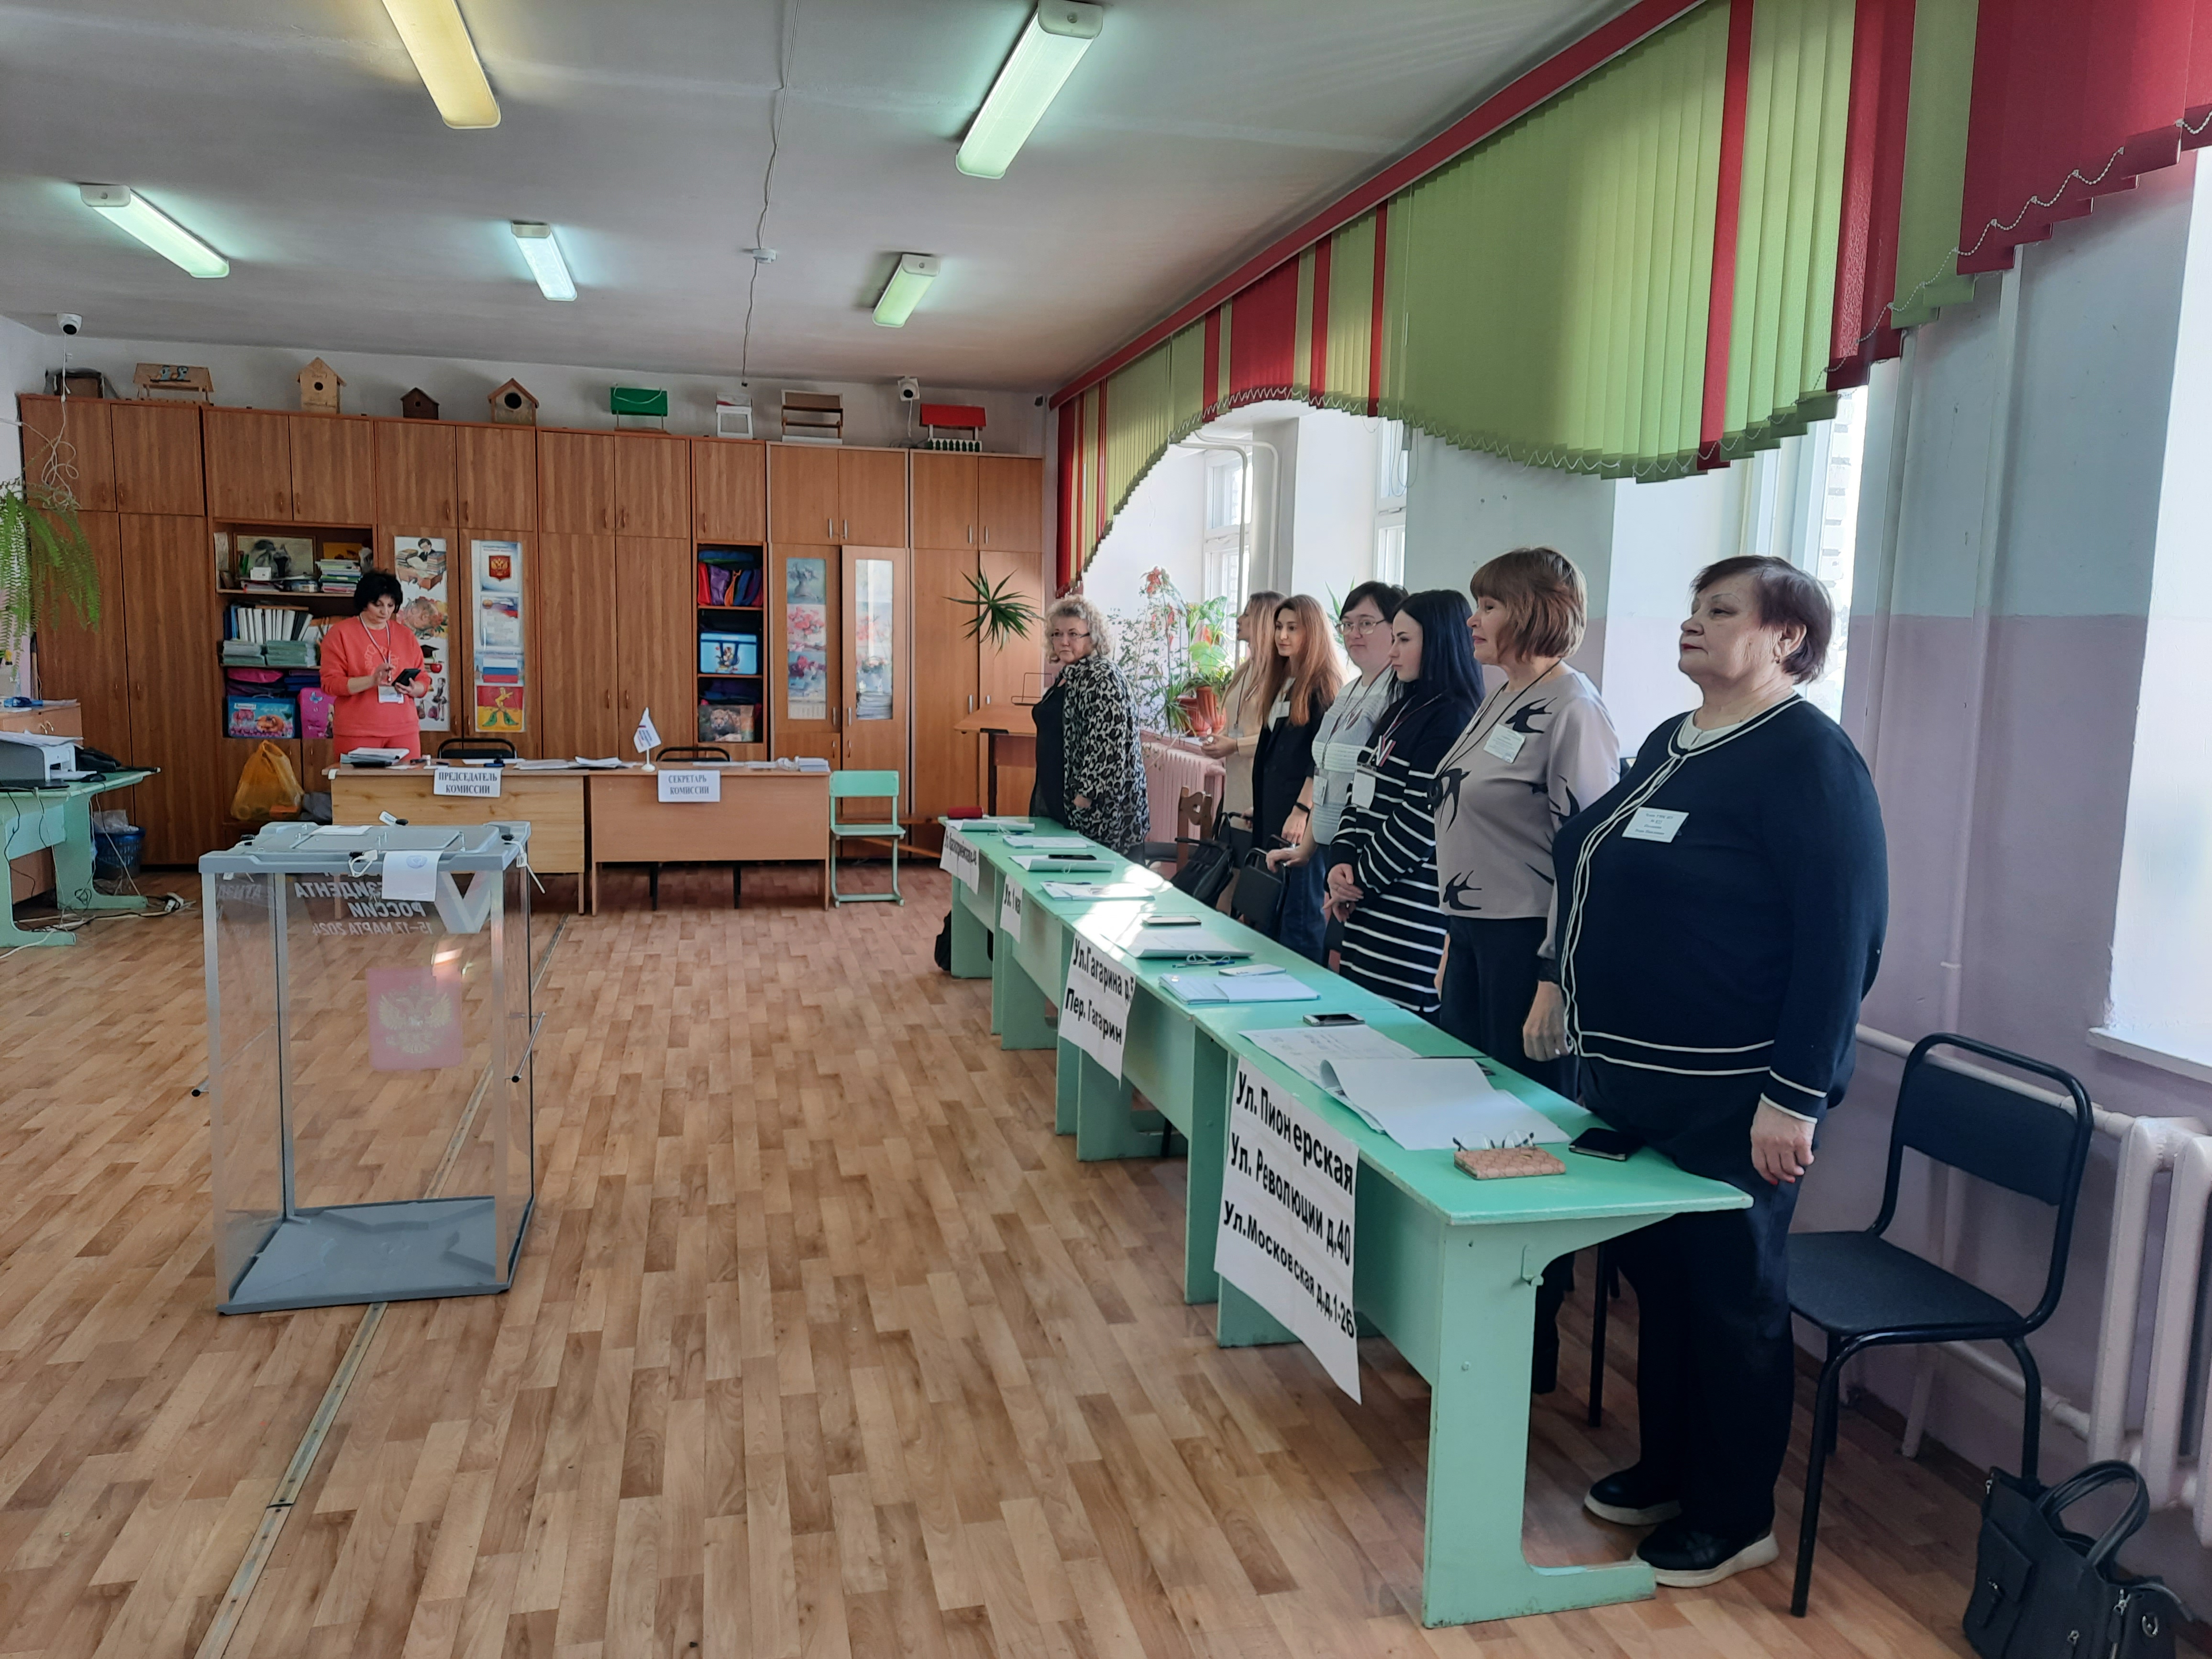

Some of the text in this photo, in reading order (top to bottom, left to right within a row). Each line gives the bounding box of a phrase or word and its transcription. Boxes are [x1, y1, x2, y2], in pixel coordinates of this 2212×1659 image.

[439, 772, 497, 782] ПРЕДСЕДАТЕЛЬ
[668, 775, 707, 784] СЕКРЕТАРЬ
[445, 785, 490, 794] КОМИССИИ
[670, 786, 709, 795] КОМИССИИ
[1065, 987, 1085, 1021] Пер.
[1261, 1086, 1353, 1196] Пионерская
[1231, 1132, 1350, 1266] Ул. Революции д.40
